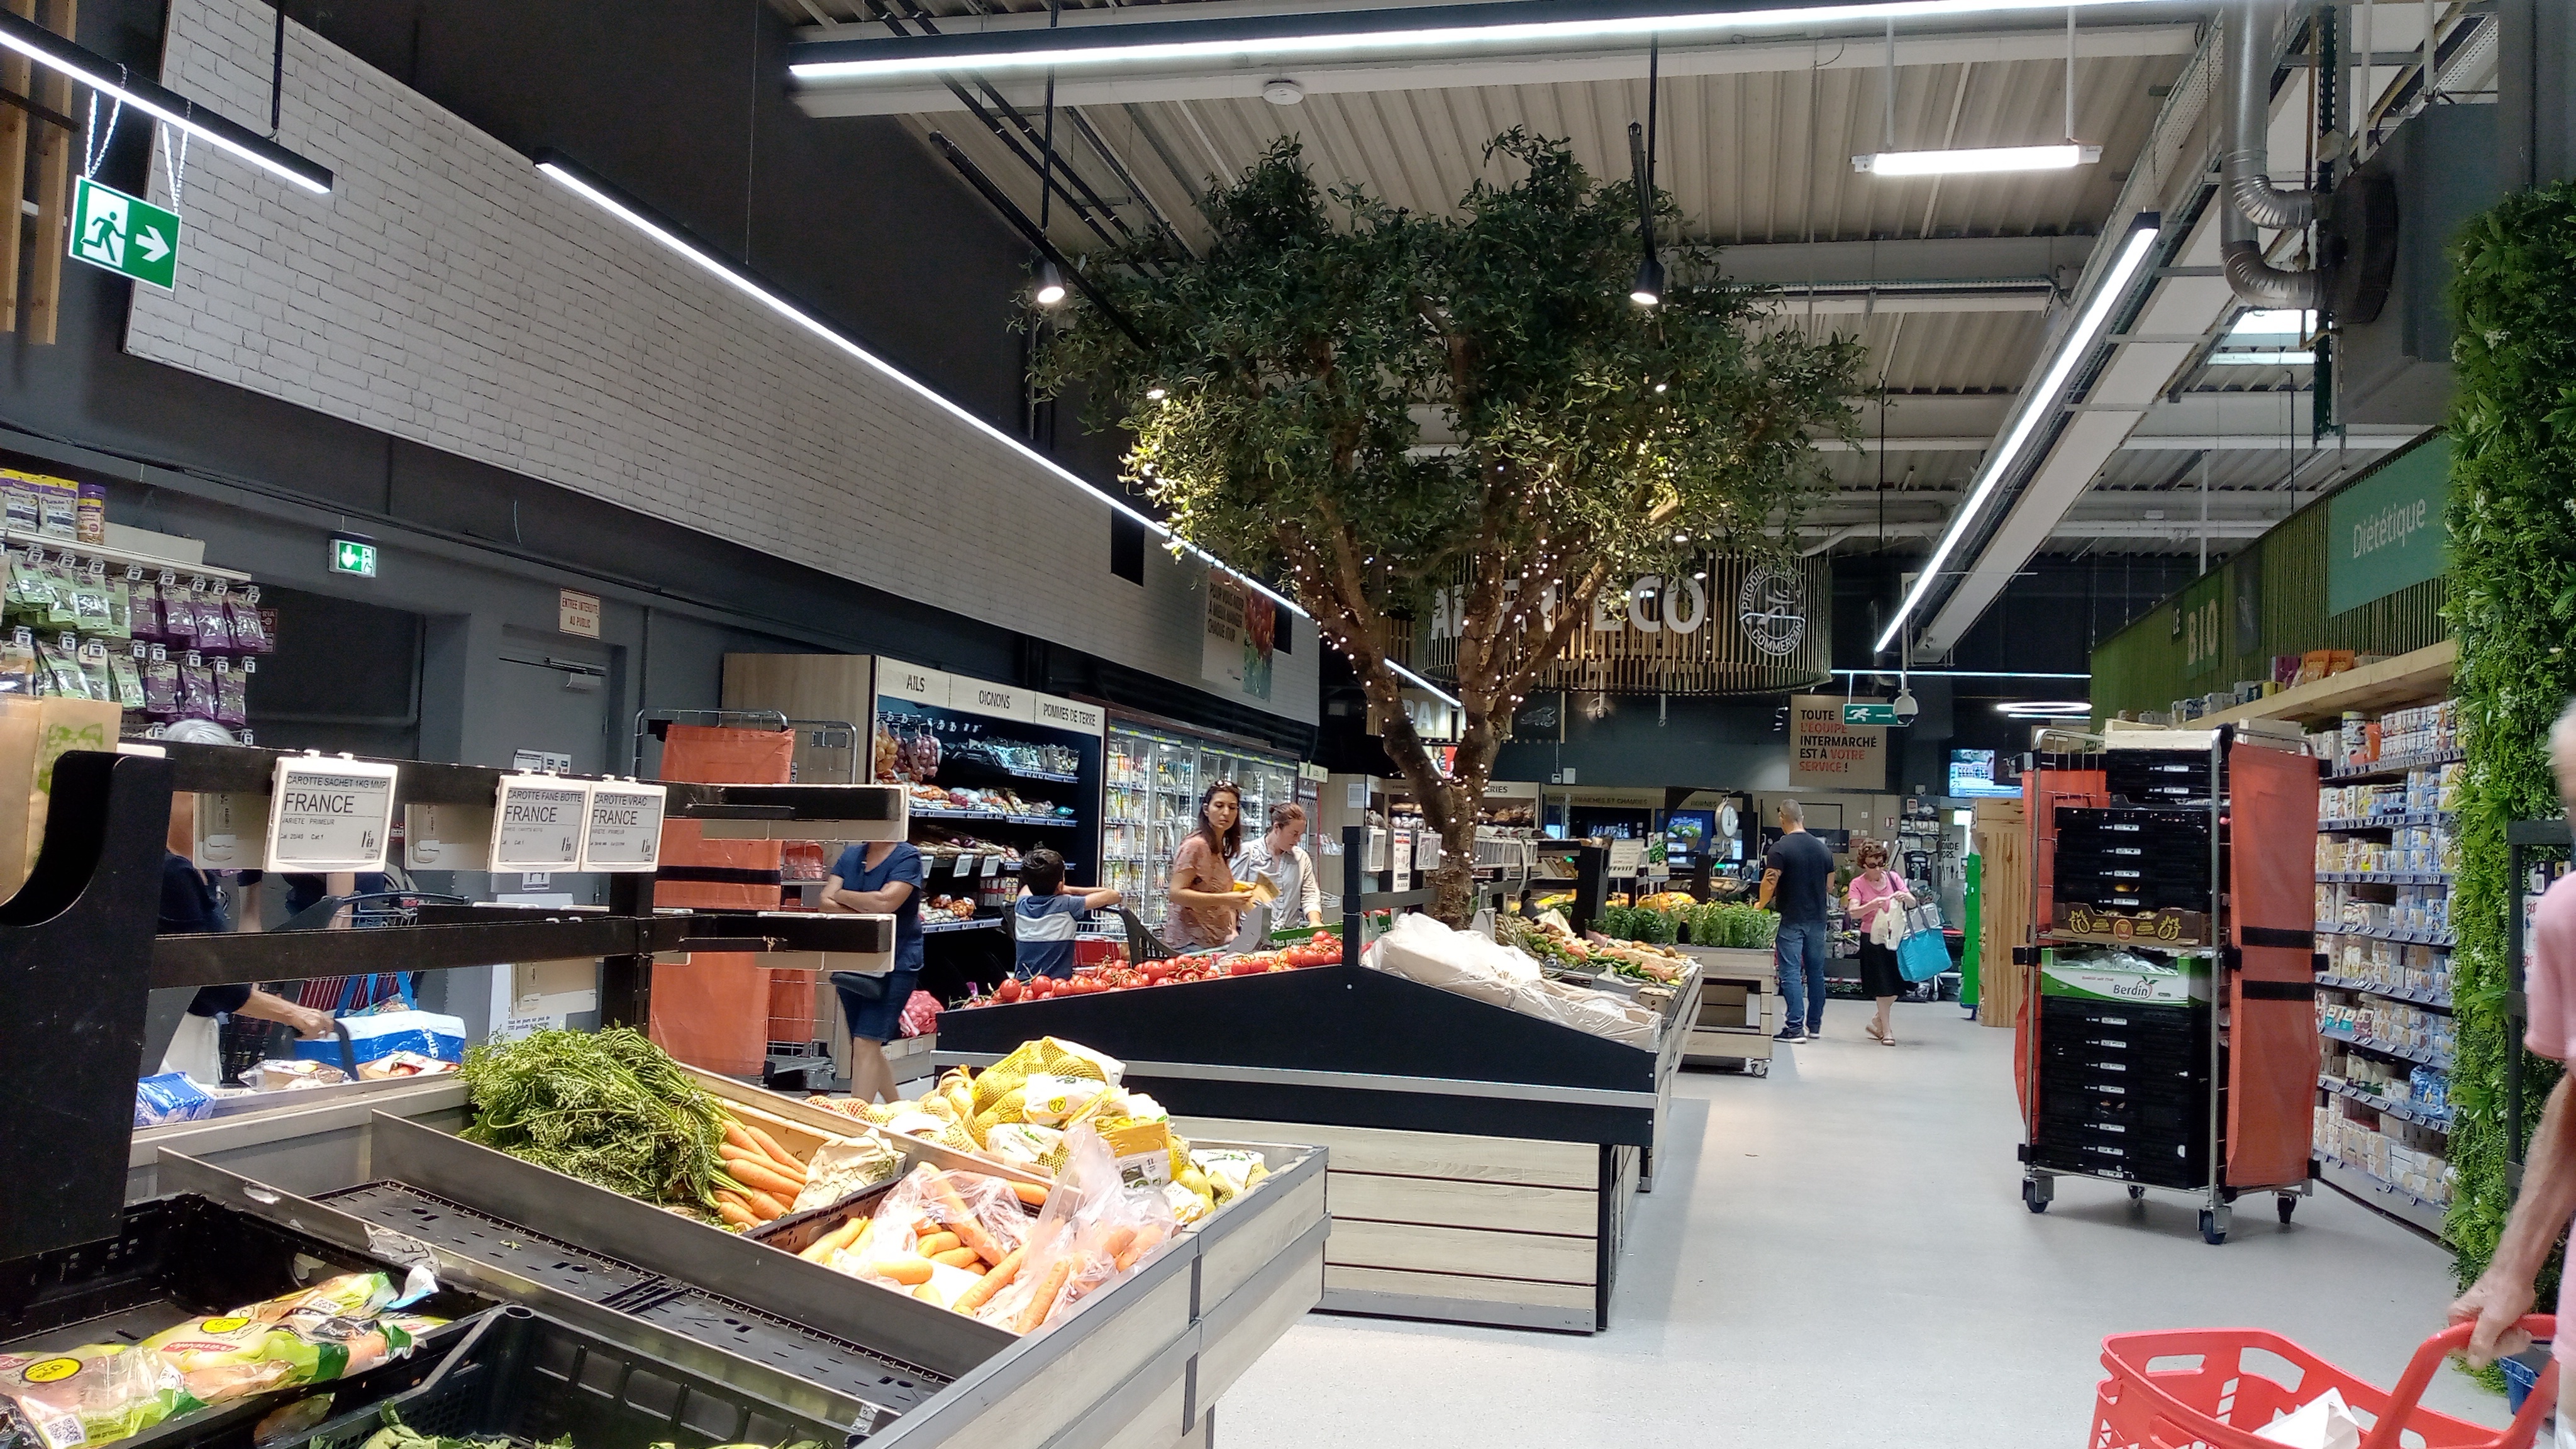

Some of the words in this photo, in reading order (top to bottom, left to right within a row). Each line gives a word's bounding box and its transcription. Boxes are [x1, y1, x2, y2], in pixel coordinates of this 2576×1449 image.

[2353, 499, 2426, 558] Diététique
[2188, 598, 2218, 666] BIO
[906, 674, 925, 692] AILS
[979, 690, 1011, 709] OIGNONS
[1043, 702, 1069, 721] POMMES
[1070, 708, 1078, 723] DE
[1079, 711, 1096, 727] TERRE
[1801, 709, 1835, 721] TOUTE
[1801, 736, 1877, 748] INTERMARCHÉ
[1800, 748, 1818, 759] EST
[1830, 749, 1865, 760] VOTRE
[1799, 761, 1841, 772] SERVICE
[287, 775, 323, 786] CAROTTE
[325, 778, 353, 787] SACHET
[356, 780, 369, 789] 1KG
[508, 790, 540, 800] CAROTTE
[541, 792, 559, 801] FANE
[560, 793, 582, 802] BOTTE
[594, 794, 626, 806] CAROTTE
[629, 797, 648, 806] VRAC
[284, 793, 355, 814] FRANCE
[504, 806, 558, 823] FRANCE
[592, 809, 638, 825] FRANCE
[1273, 939, 1285, 947] Des
[2113, 983, 2148, 997] Berdin
